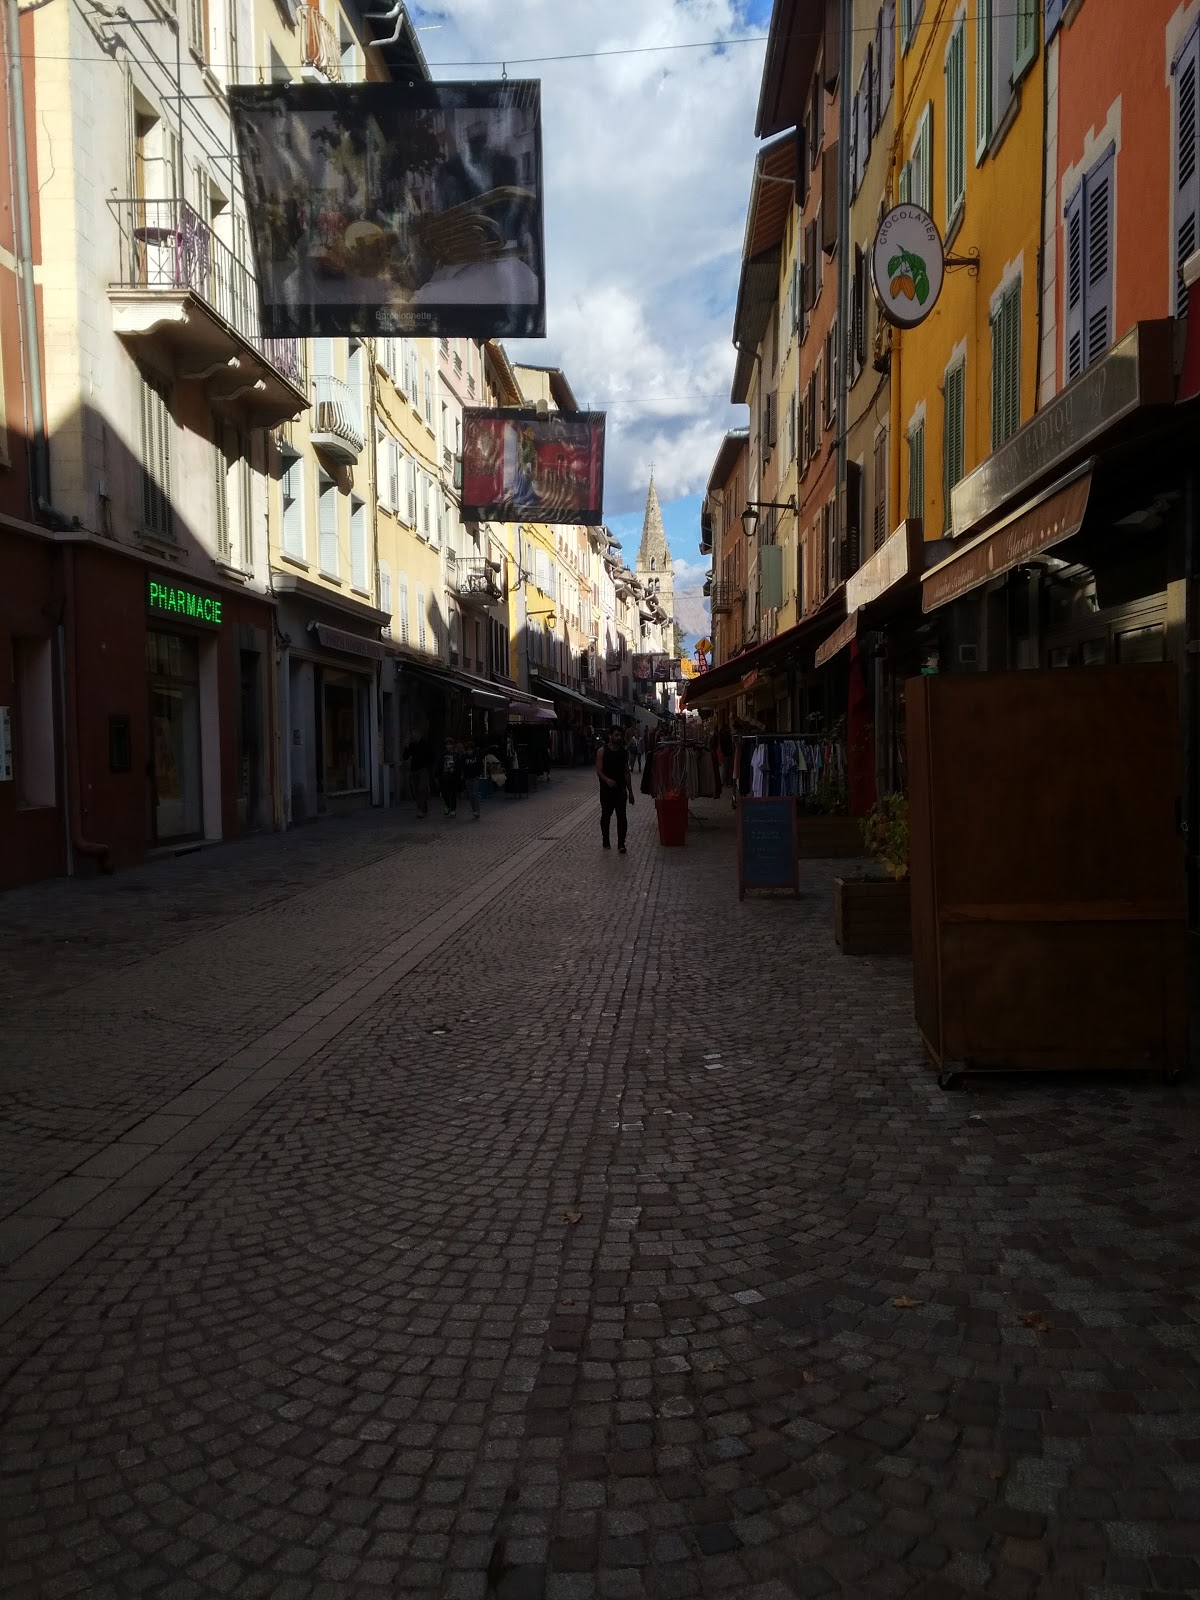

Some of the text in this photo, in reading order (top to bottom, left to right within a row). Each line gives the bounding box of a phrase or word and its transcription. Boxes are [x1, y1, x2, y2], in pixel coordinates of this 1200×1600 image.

[879, 210, 936, 245] CHOCOLATIER
[375, 310, 432, 321] Barcelonnette
[1025, 396, 1073, 458] PADIOU
[149, 581, 222, 624] PHARMACIE
